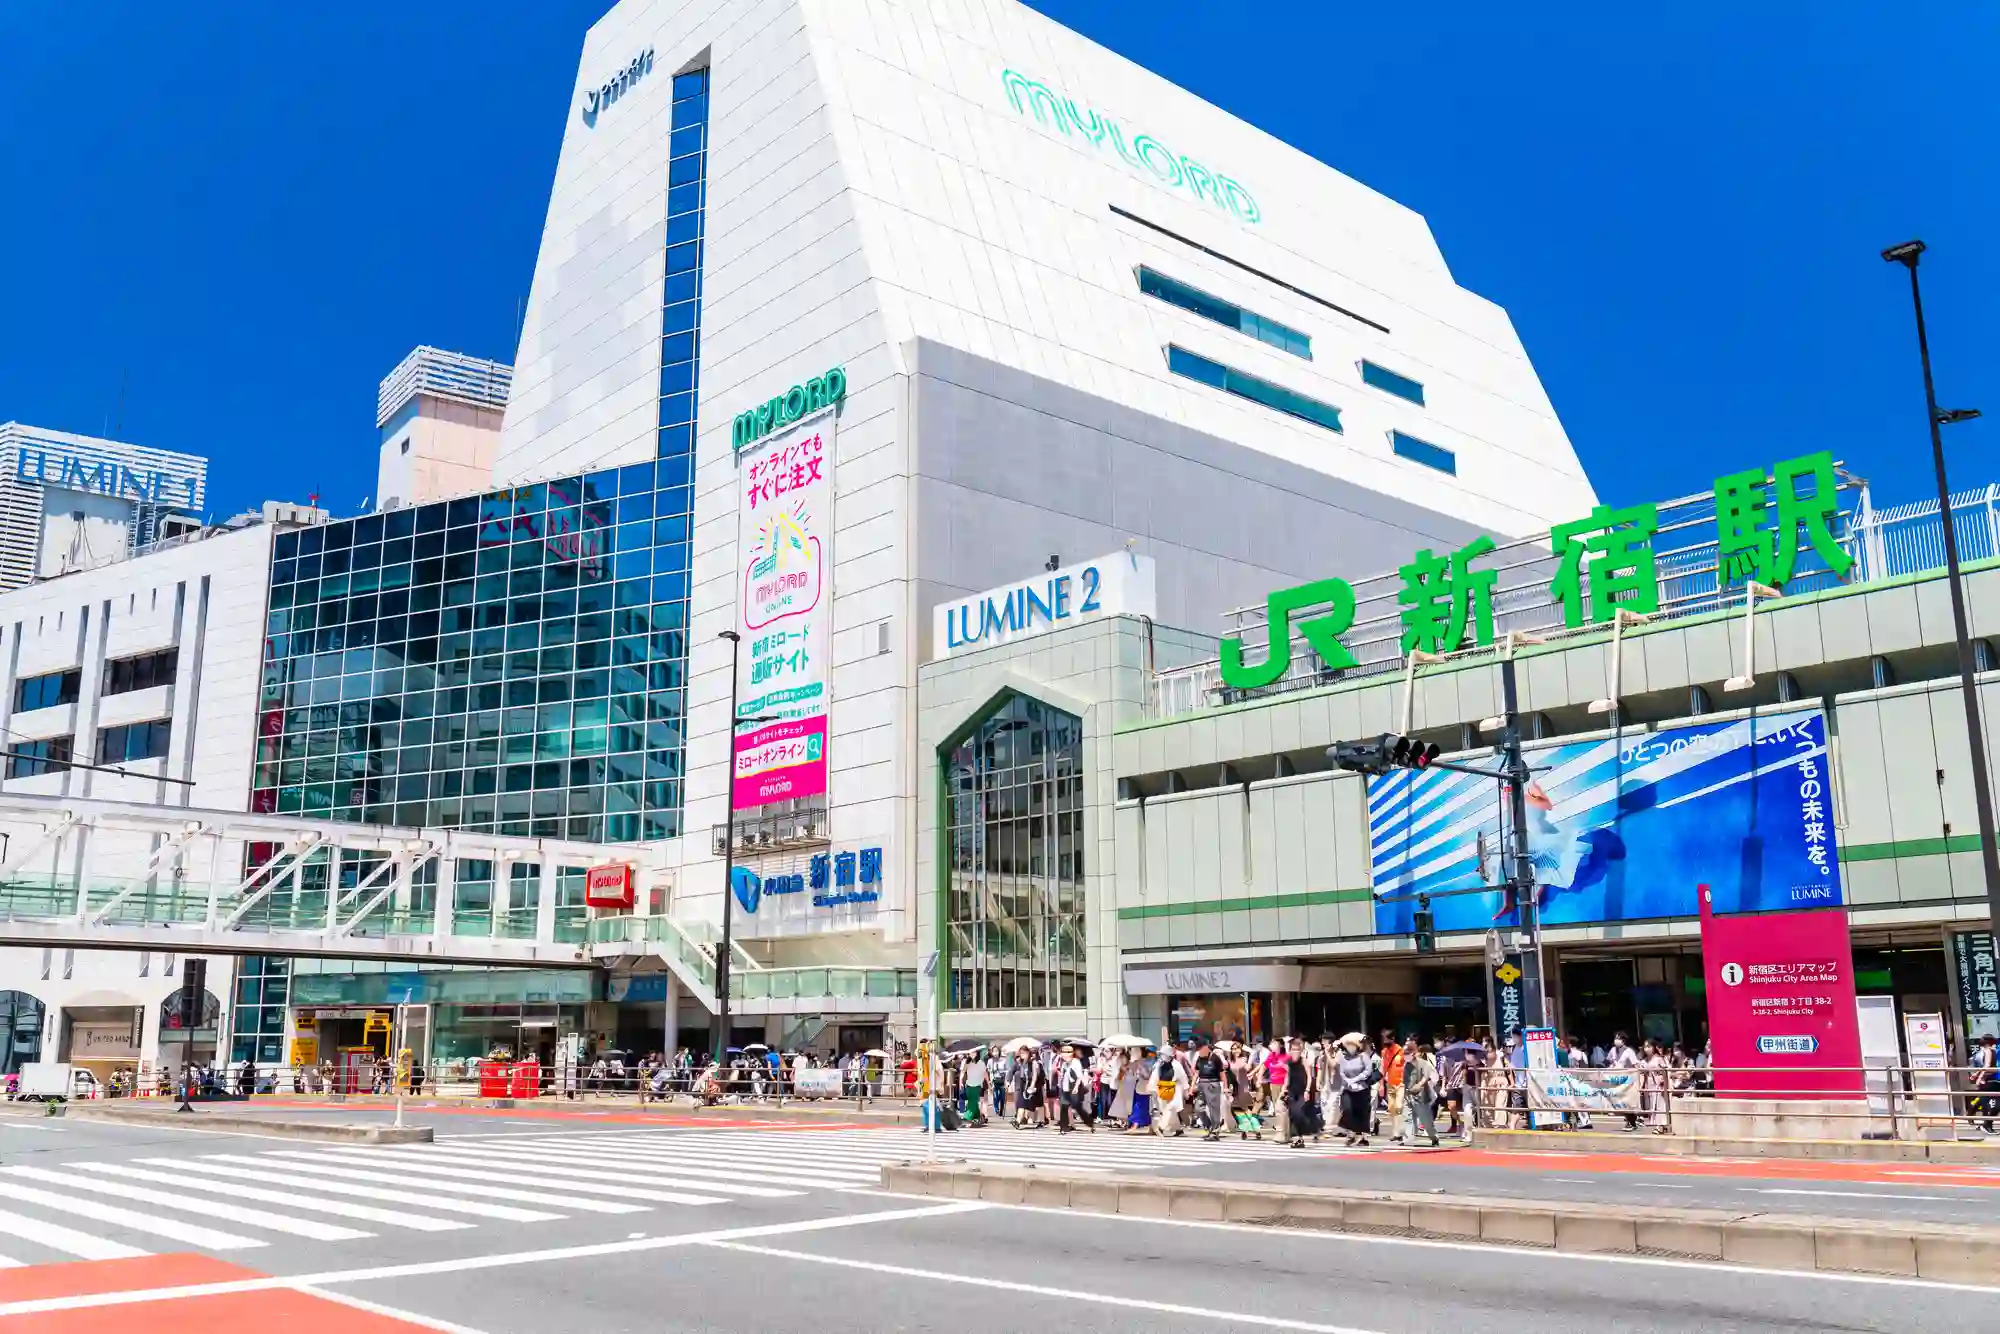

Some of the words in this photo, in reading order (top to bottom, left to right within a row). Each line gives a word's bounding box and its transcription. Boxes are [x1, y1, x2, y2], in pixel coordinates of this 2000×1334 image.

[732, 367, 847, 450] MYLORD
[750, 432, 823, 480] オンラインでも
[747, 456, 823, 510] すぐに注文
[1220, 450, 1857, 689] JR新宿駅
[947, 574, 1071, 649] LUMINE
[1080, 565, 1101, 613] 2
[751, 647, 810, 684] 通販サイト
[738, 743, 805, 770] ミロードオンライン
[810, 848, 882, 889] 新宿駅
[1791, 887, 1832, 900] LUMINE
[1748, 962, 1837, 975] 新宿区エリアマップ
[1749, 975, 1781, 984] Shinjuku
[1783, 974, 1798, 983] City
[1800, 974, 1818, 982] Area
[1820, 973, 1838, 982] Map
[1972, 933, 1999, 1012] 三角広場
[1773, 1008, 1800, 1016] Shinjuku
[1801, 1008, 1814, 1016] City
[1763, 1038, 1810, 1051] 甲州街道
